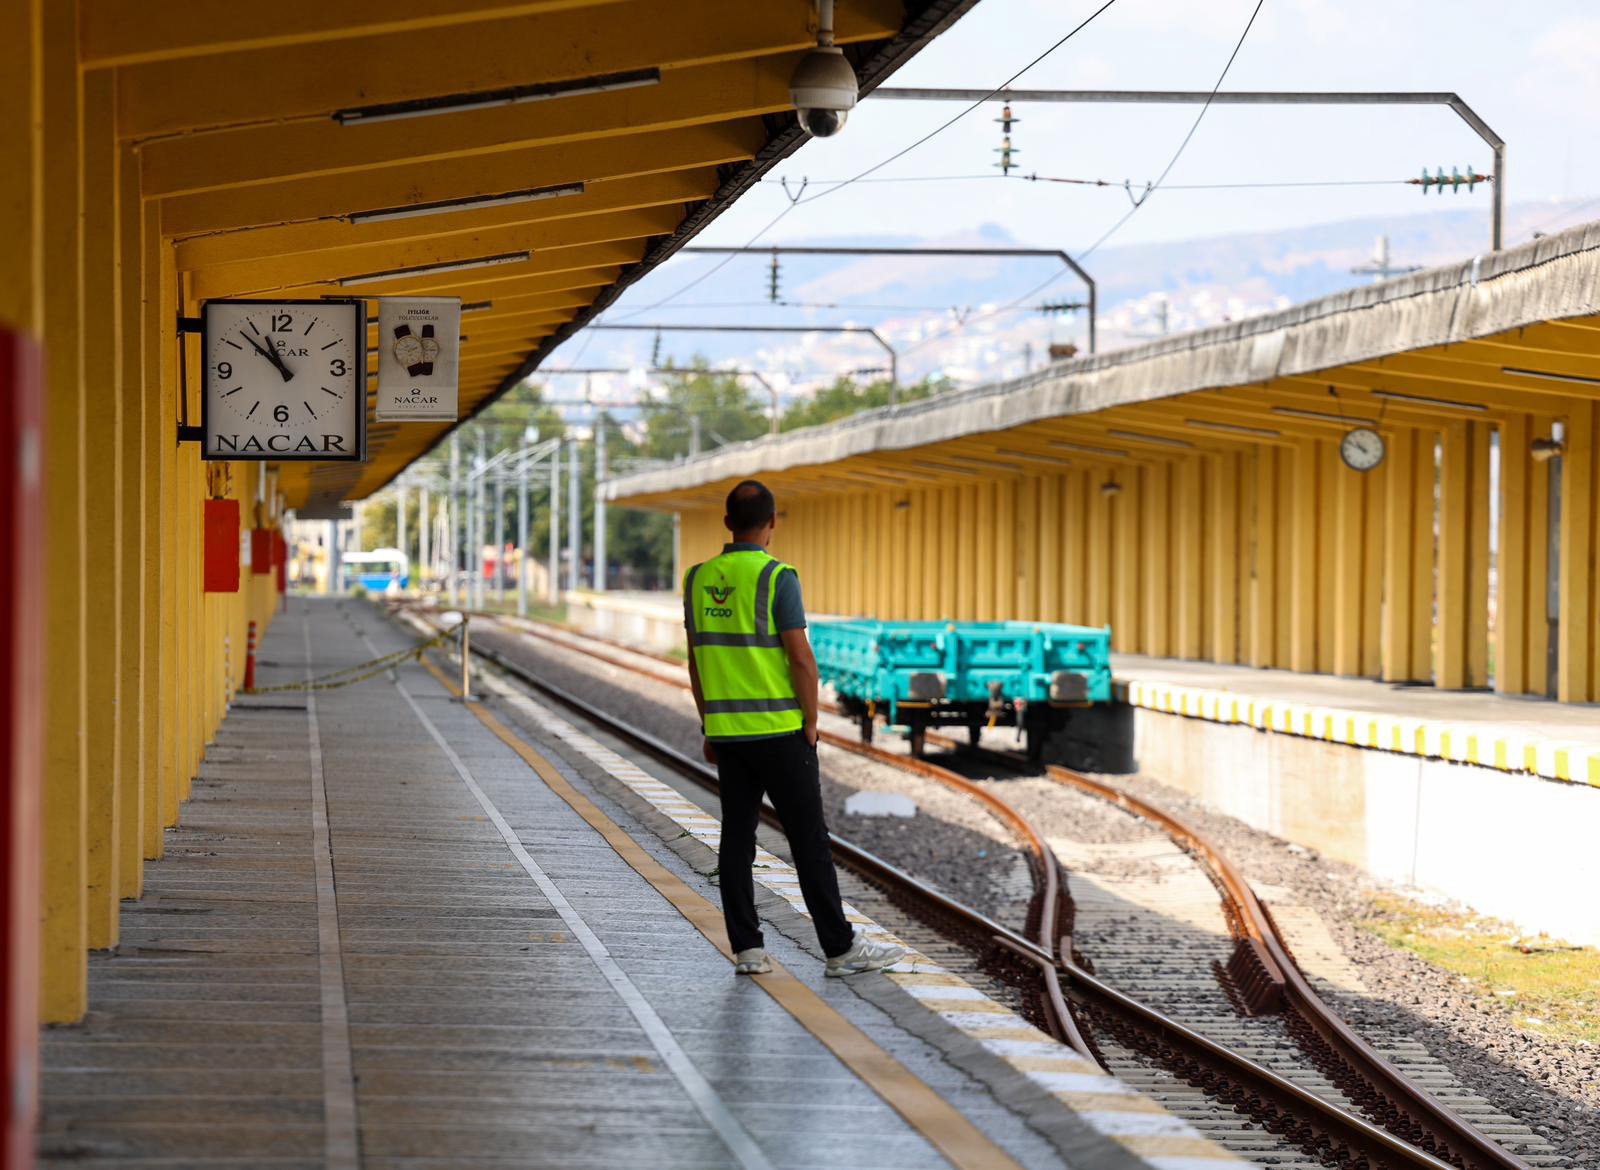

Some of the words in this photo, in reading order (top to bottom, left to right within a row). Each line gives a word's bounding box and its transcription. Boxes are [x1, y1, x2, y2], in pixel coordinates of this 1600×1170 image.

[272, 314, 293, 332] 12
[217, 362, 233, 380] 9
[329, 359, 347, 377] 3
[394, 396, 438, 404] NACAR
[273, 405, 289, 423] 6
[215, 434, 347, 452] NACAR
[704, 607, 733, 618] TCDD
